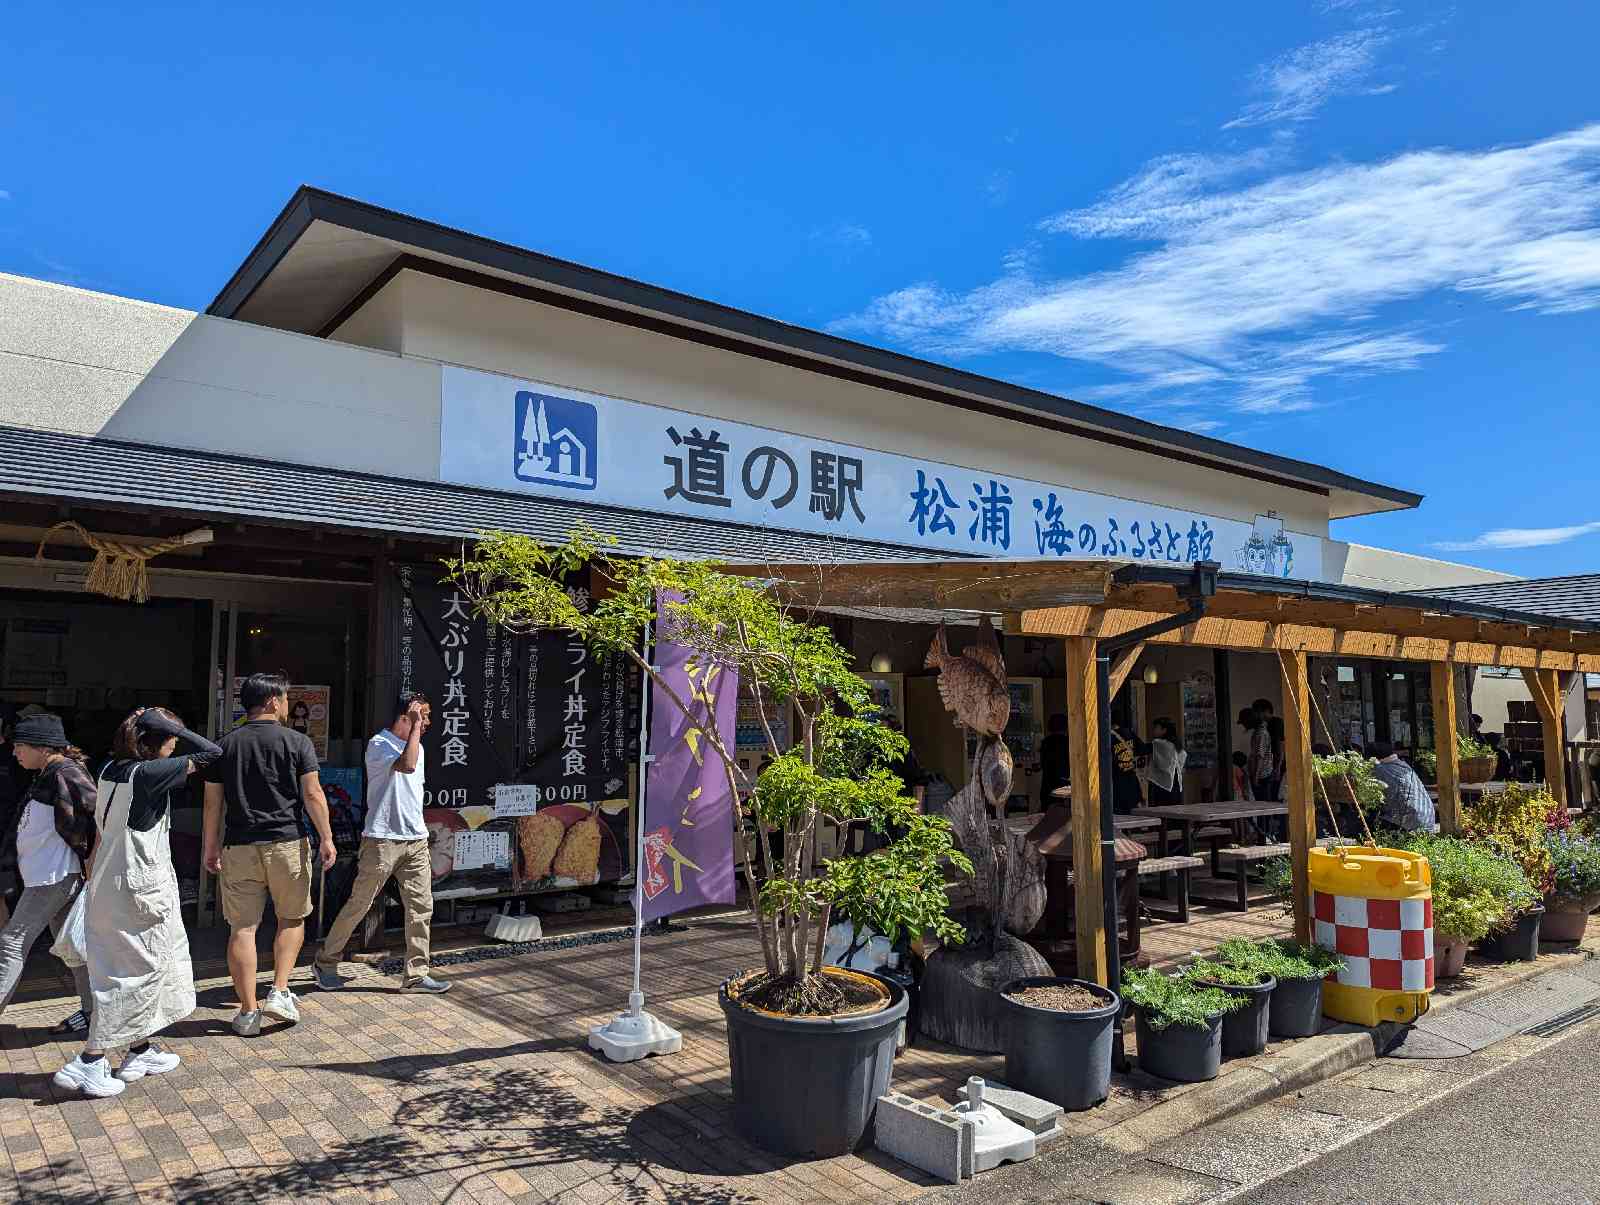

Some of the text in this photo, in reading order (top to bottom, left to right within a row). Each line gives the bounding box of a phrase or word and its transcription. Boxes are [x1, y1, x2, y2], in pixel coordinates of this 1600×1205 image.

[664, 427, 867, 524] 道の駅
[909, 469, 1013, 551] 松浦
[440, 591, 471, 767] 大ぶり丼定食
